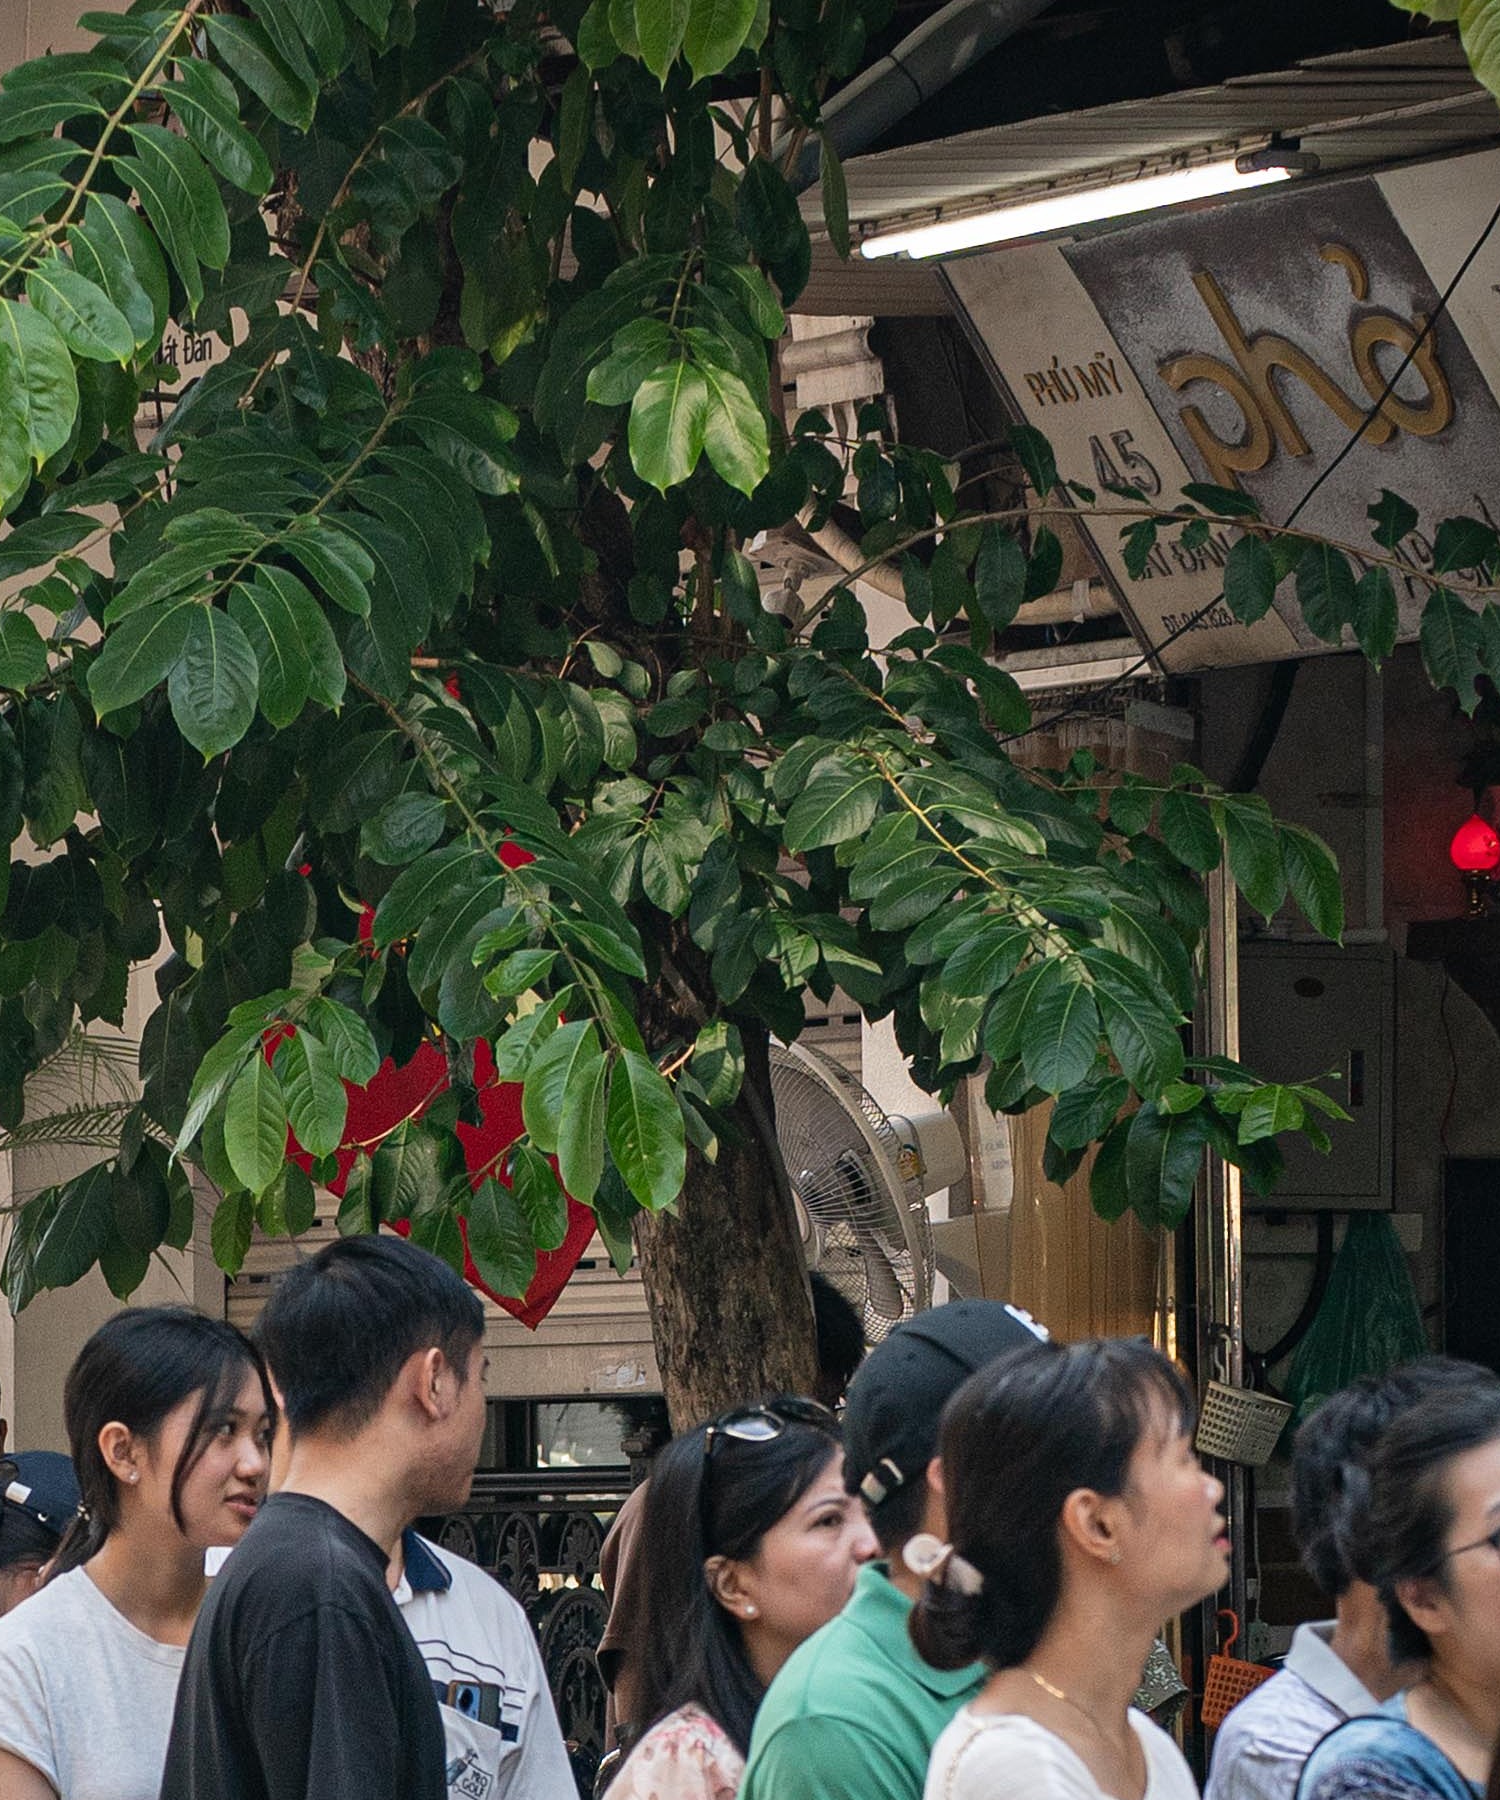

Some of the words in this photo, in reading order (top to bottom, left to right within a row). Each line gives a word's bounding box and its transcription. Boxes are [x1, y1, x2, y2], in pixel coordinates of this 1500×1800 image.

[1024, 356, 1079, 407] PHÚ
[1158, 243, 1454, 538] phở
[1089, 428, 1161, 496] 45
[462, 1777, 484, 1798] GOLF
